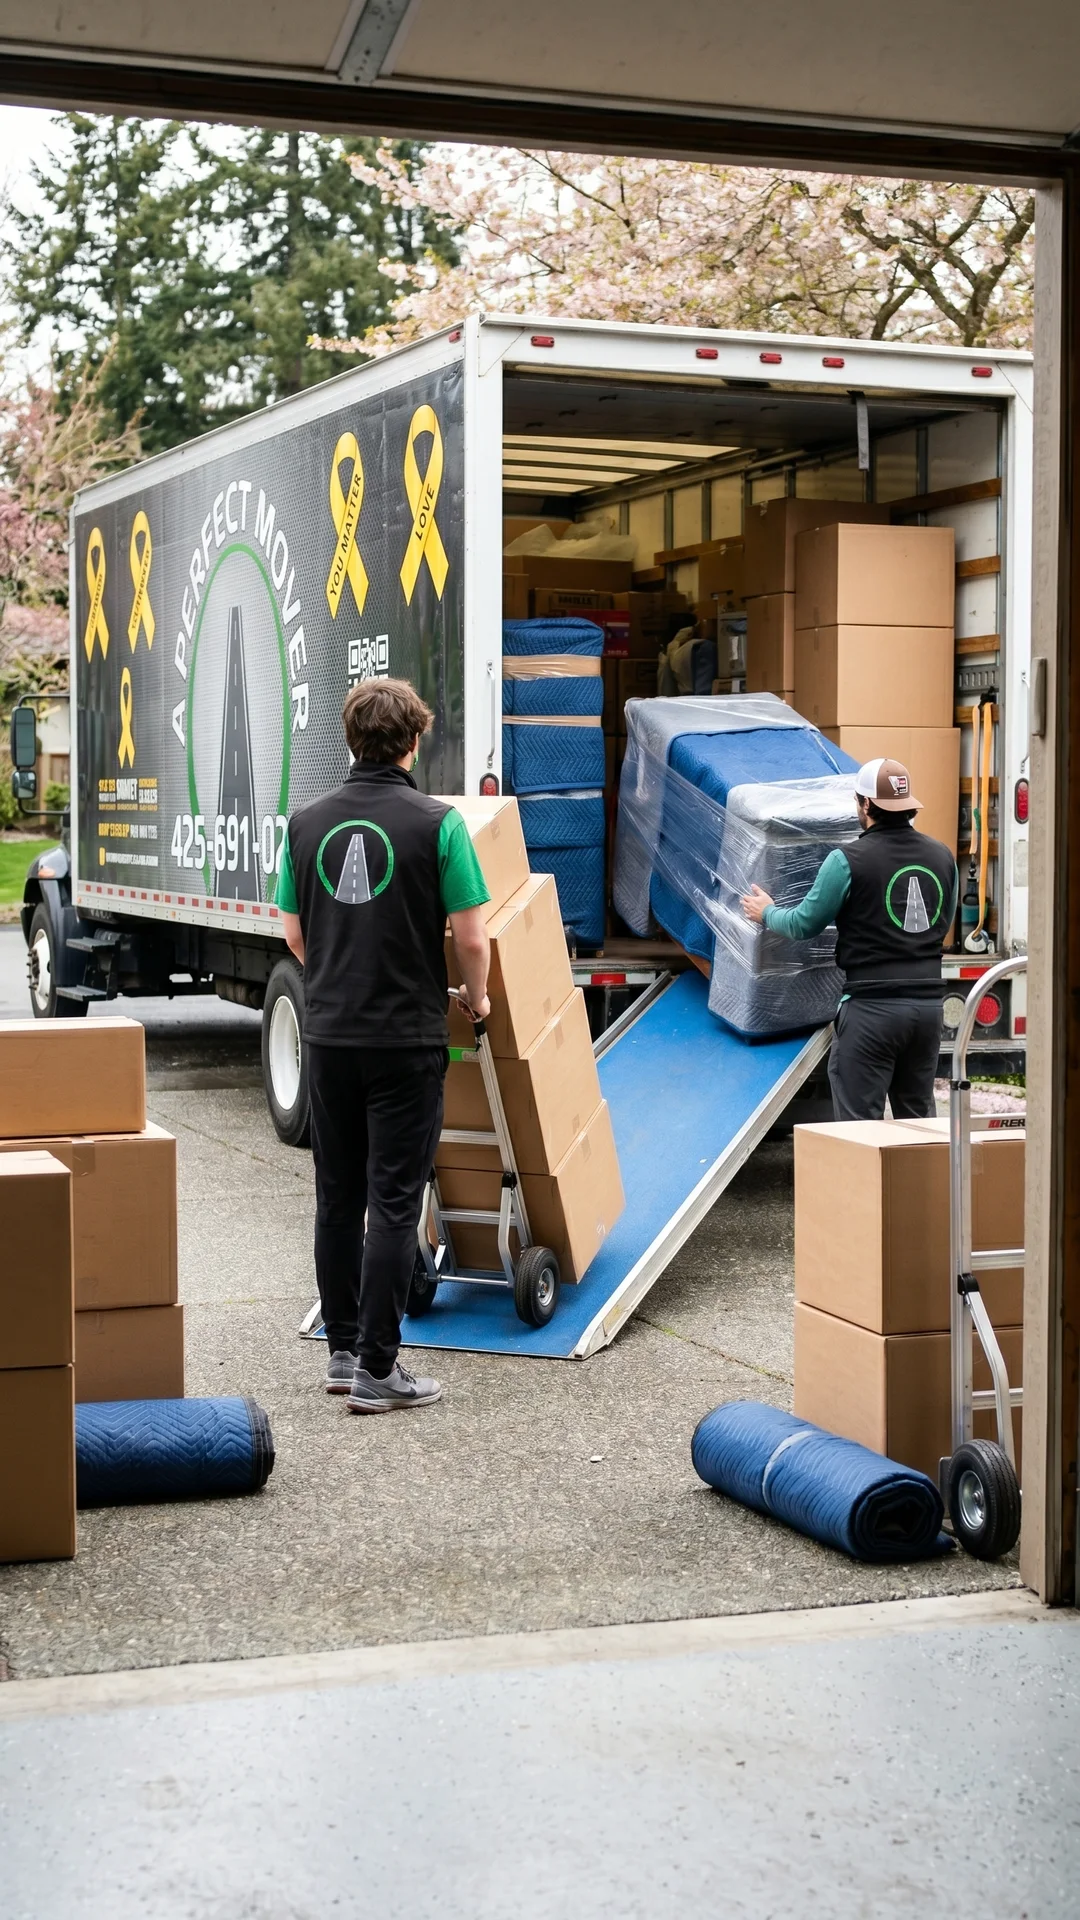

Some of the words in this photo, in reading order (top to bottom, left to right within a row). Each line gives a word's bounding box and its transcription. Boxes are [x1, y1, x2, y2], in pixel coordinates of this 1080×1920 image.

[329, 556, 344, 596] YOU
[341, 473, 362, 554] MATTER
[415, 483, 435, 541] LOVE
[174, 479, 252, 683] PERFECT
[254, 488, 309, 734] MOVER
[172, 698, 186, 748] A
